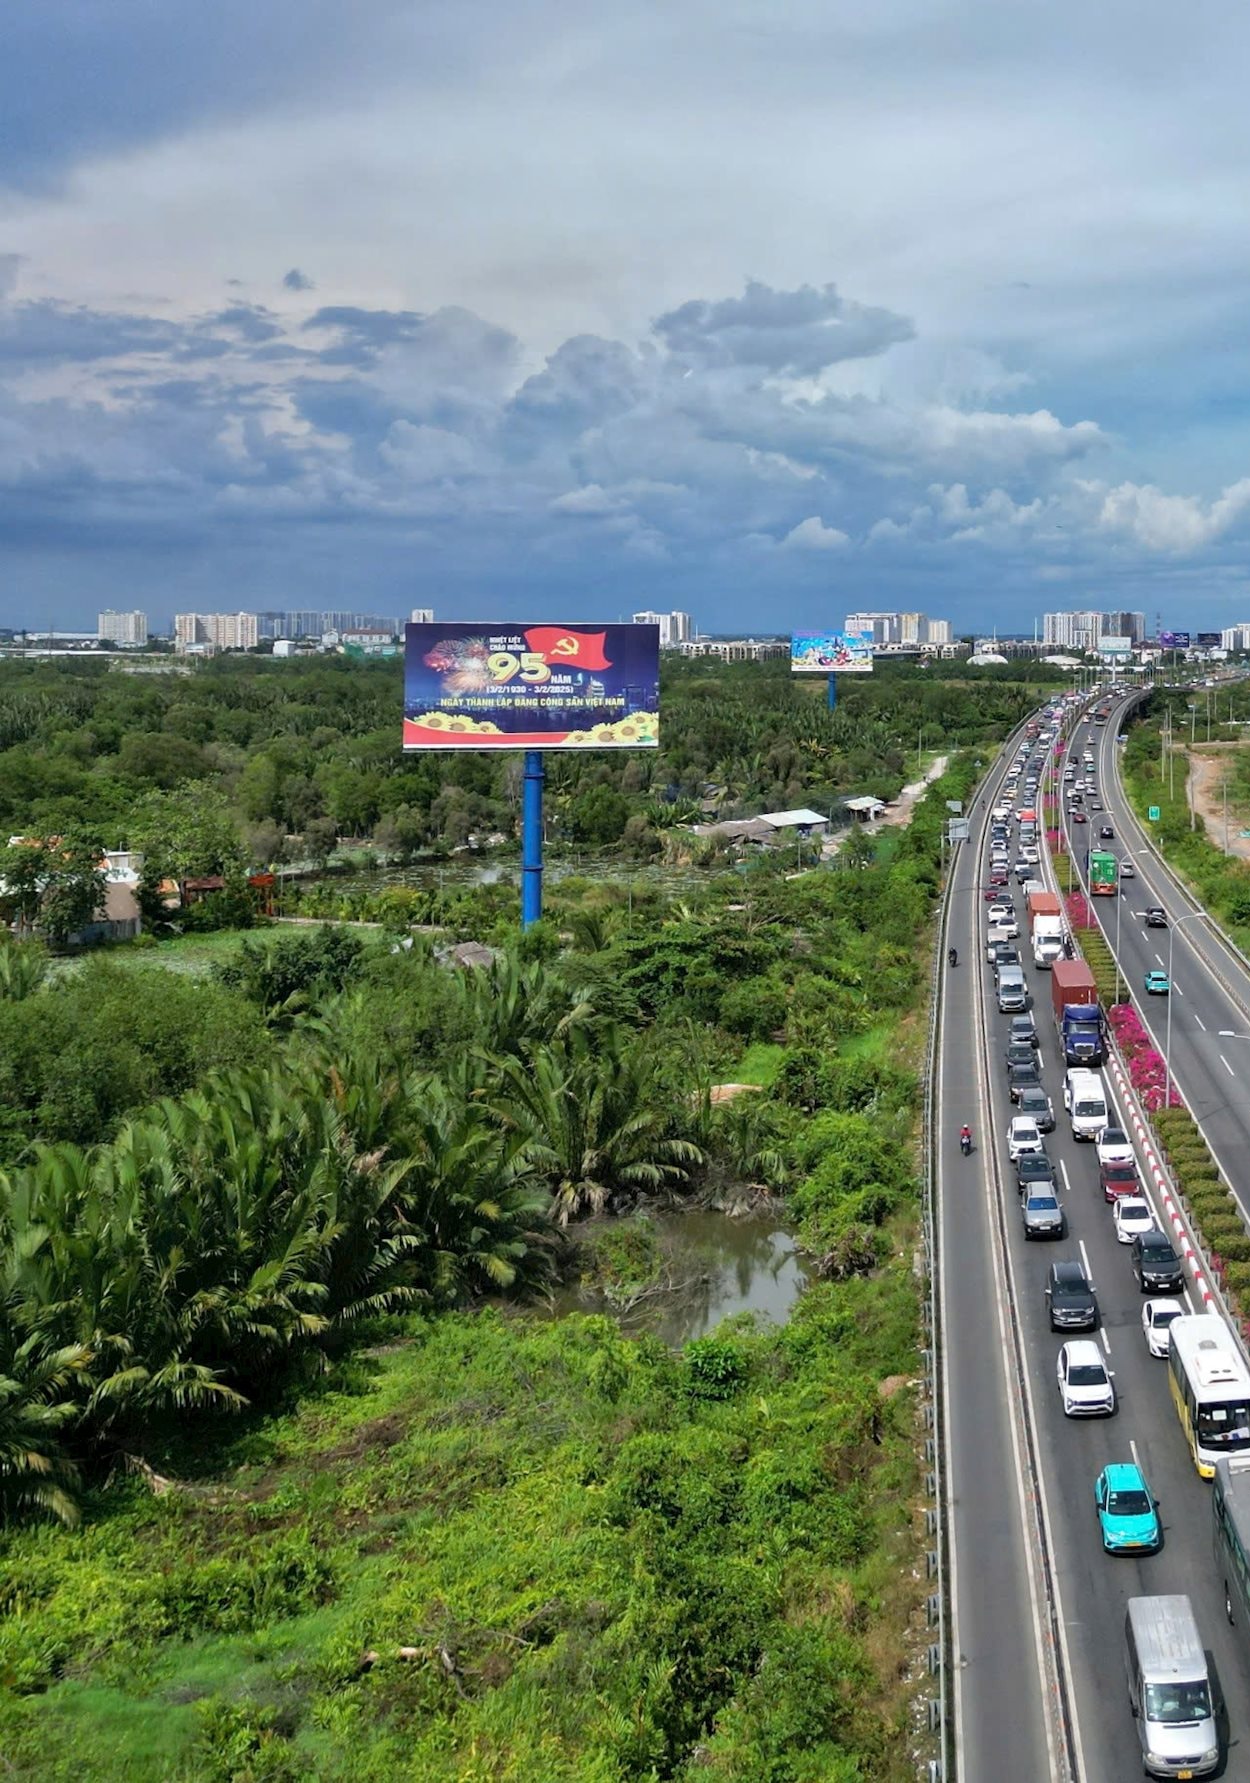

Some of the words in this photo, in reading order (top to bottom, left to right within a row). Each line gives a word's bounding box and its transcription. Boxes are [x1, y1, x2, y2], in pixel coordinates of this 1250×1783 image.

[487, 652, 551, 685] 95
[551, 674, 572, 684] NĂM
[605, 697, 625, 706] NAM
